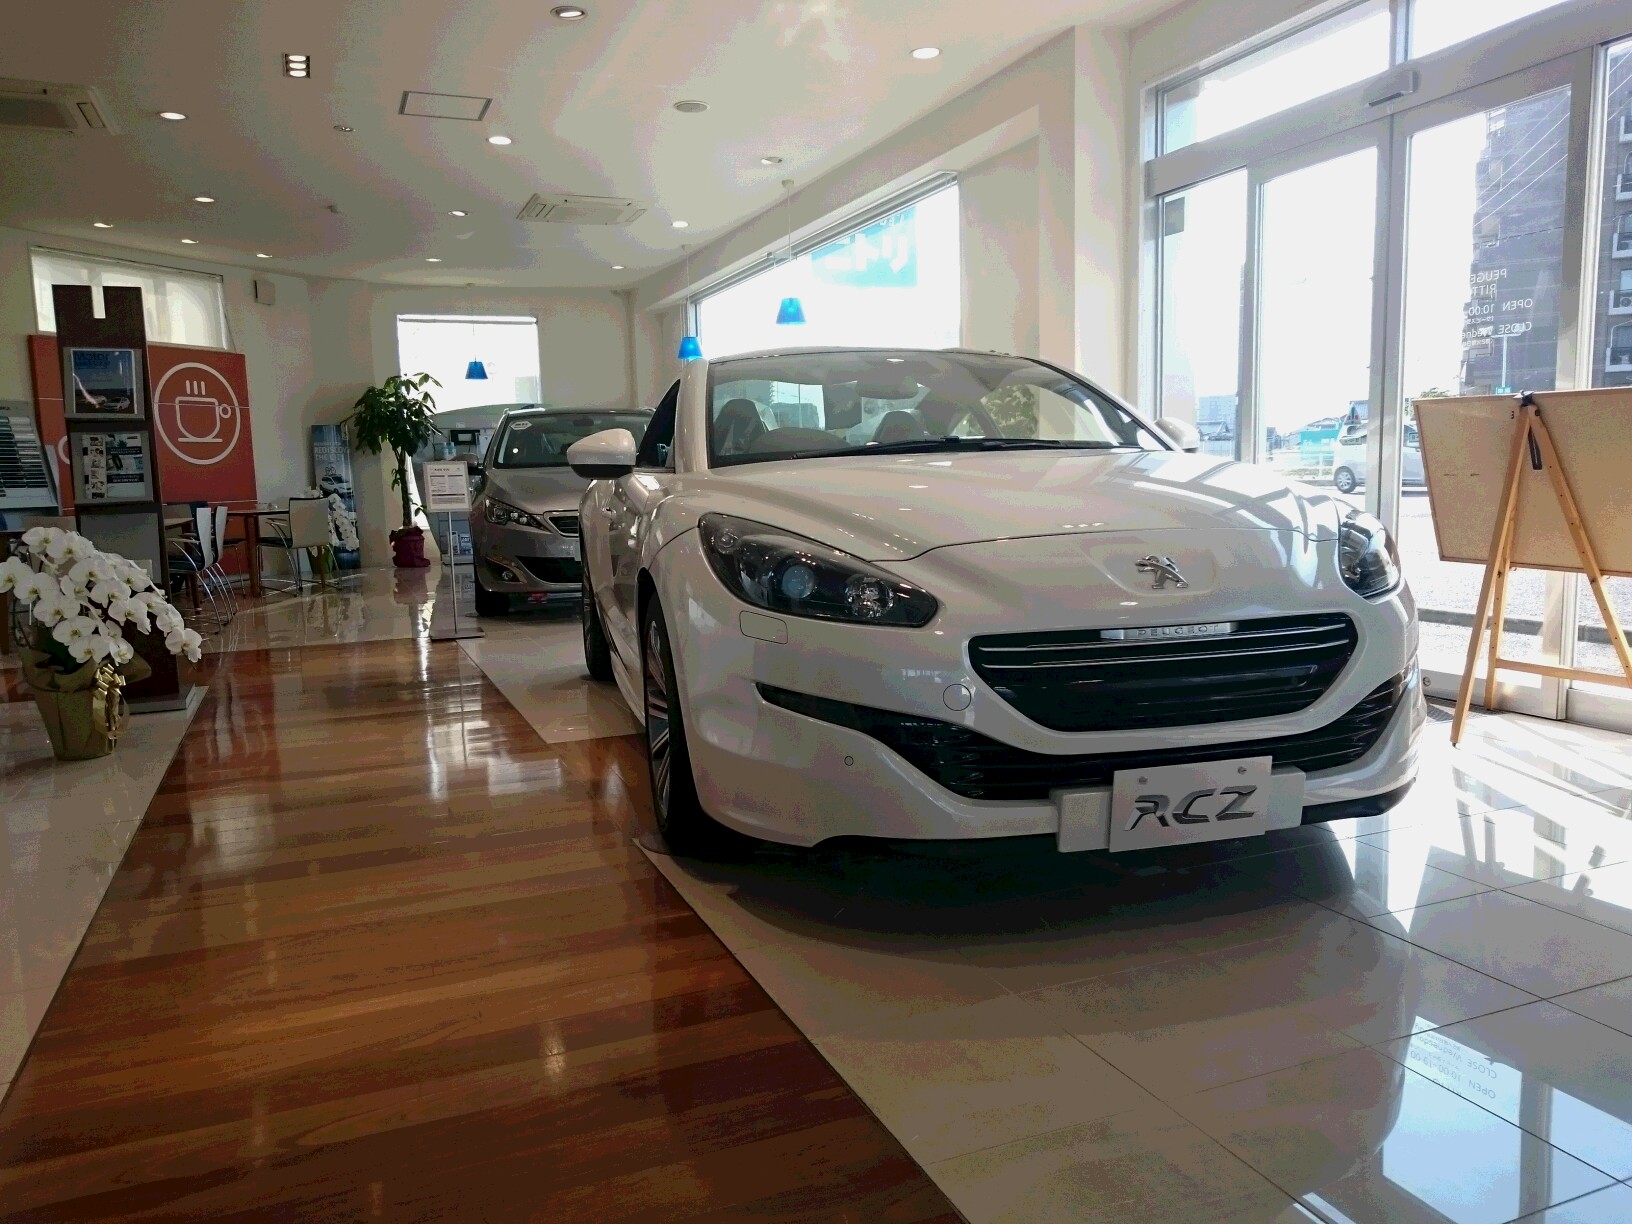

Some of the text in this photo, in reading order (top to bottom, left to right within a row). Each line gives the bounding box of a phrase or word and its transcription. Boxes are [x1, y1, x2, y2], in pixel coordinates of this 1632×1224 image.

[824, 233, 908, 272] ニトリ
[1137, 623, 1220, 637] PEUGEOT
[1123, 785, 1258, 831] RCZ
[1467, 1059, 1497, 1079] CLOSE
[1468, 1079, 1497, 1100] OPEN
